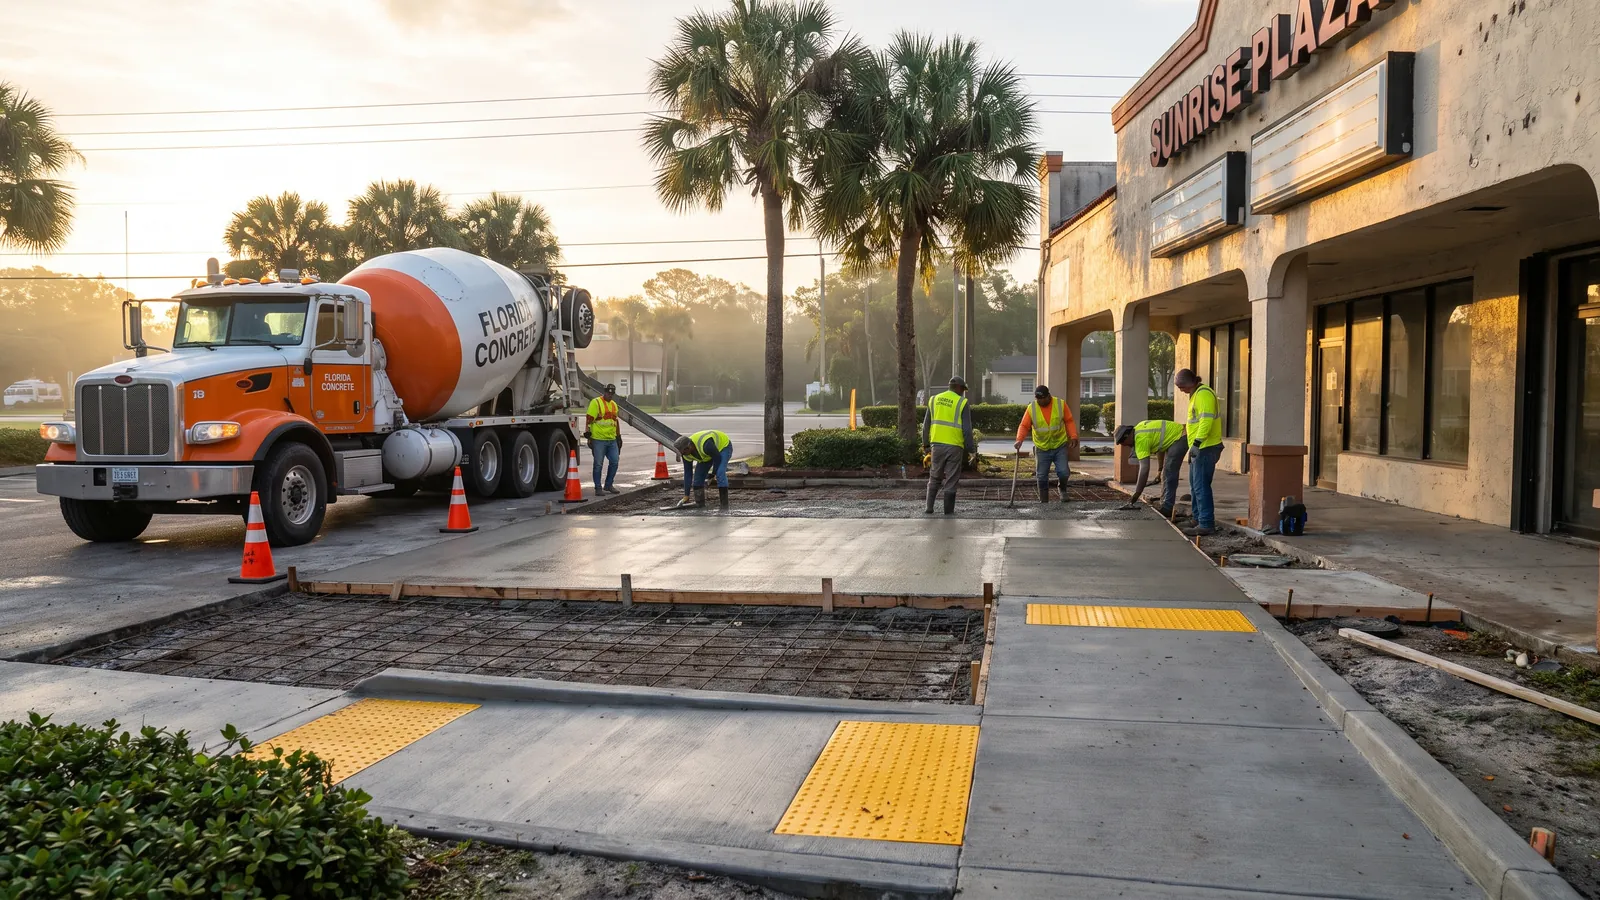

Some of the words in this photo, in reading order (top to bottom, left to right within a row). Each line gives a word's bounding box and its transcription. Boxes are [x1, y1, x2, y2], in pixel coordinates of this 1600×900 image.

[1150, 47, 1243, 167] SUNRISE
[478, 298, 533, 338] FLORIDA
[475, 321, 537, 368] CONCRETE
[321, 382, 355, 391] CONCRETE
[324, 373, 352, 382] FLORIDA
